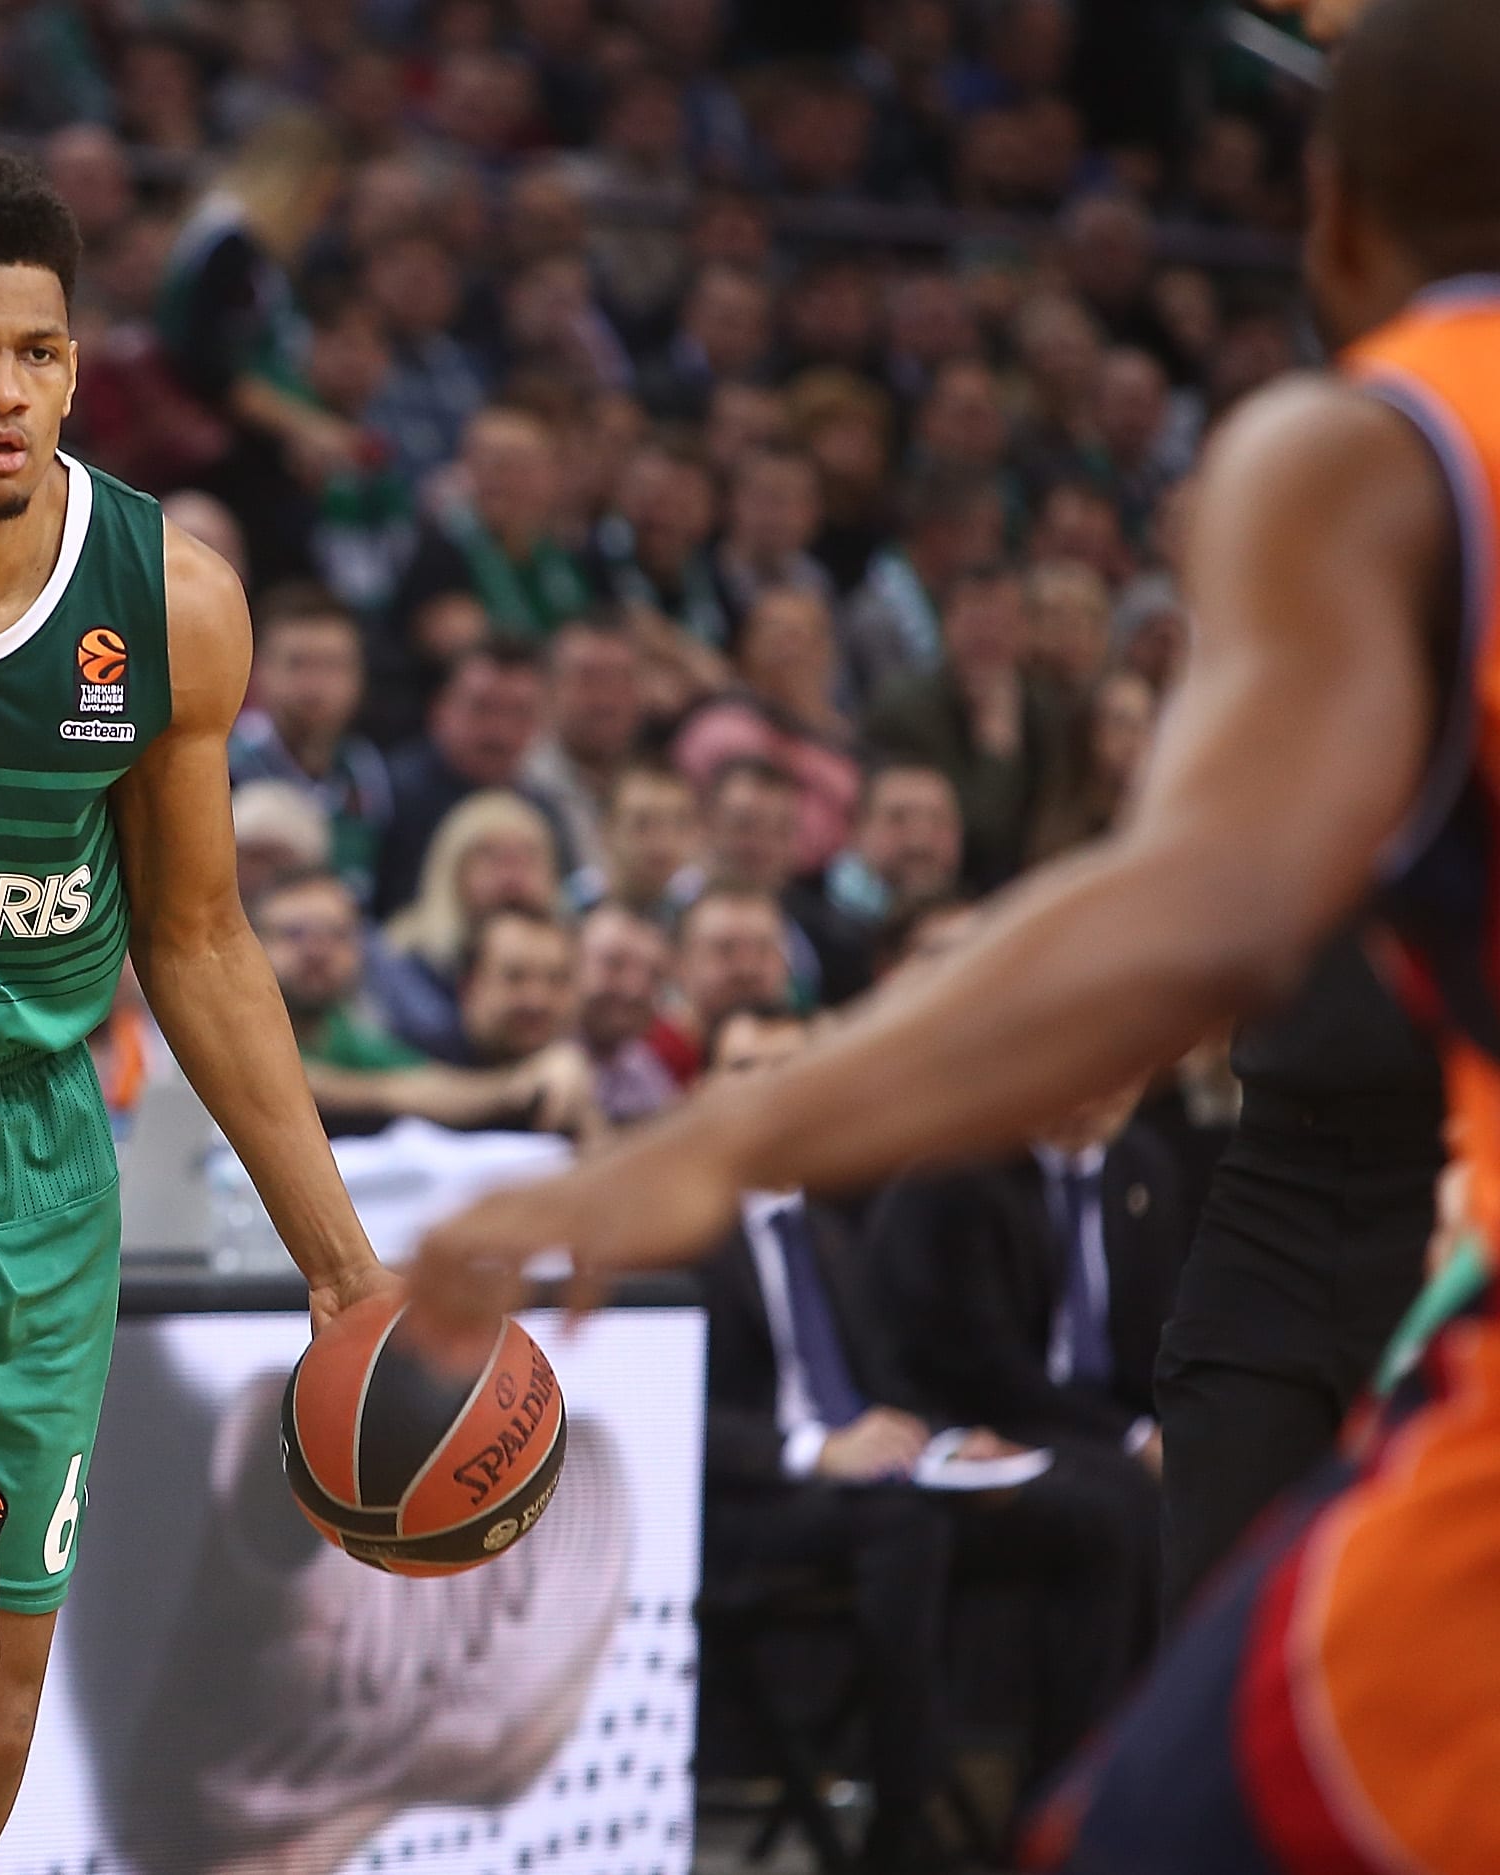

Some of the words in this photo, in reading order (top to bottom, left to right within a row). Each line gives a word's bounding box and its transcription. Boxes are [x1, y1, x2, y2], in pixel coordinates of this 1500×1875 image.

[80, 684, 124, 695] TURKISH
[80, 693, 124, 704] AIRLINES
[62, 722, 134, 739] oneteam
[43, 1452, 83, 1574] 6
